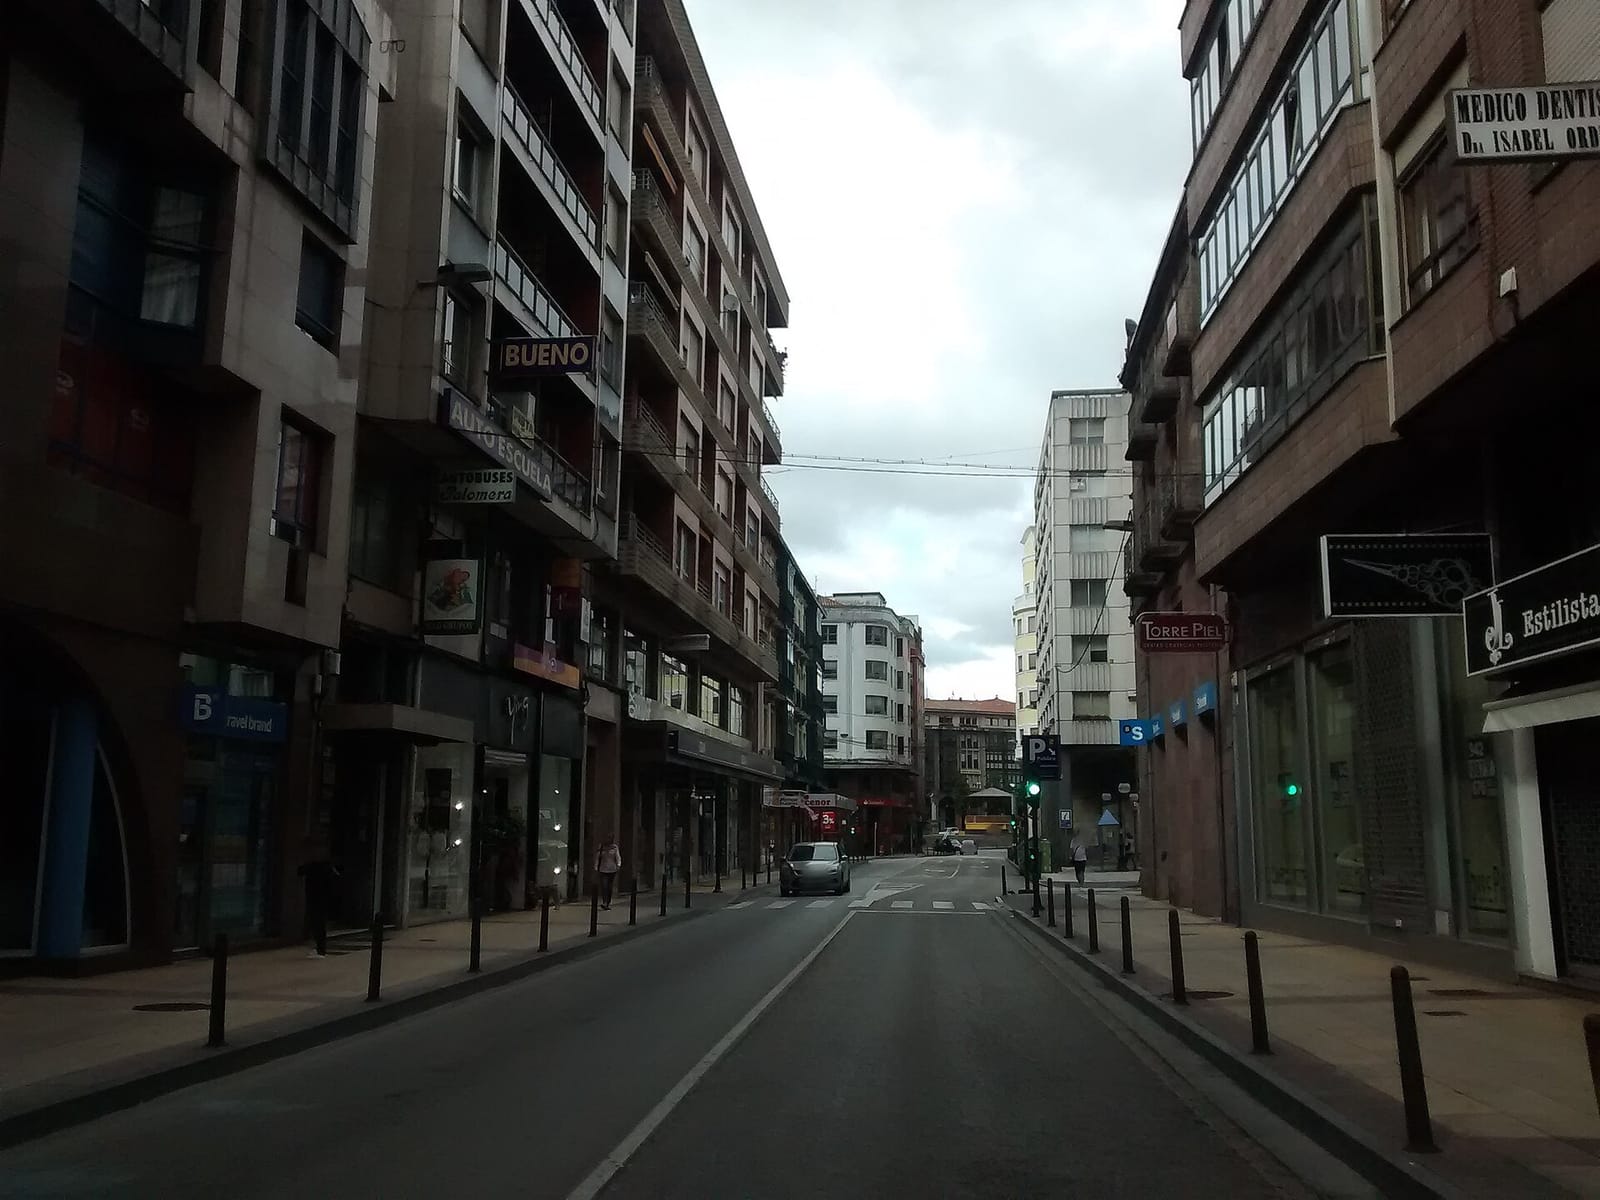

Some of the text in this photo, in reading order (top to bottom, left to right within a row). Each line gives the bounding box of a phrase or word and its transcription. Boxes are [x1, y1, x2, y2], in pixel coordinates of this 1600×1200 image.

[1456, 92, 1527, 124] MEDICO
[1493, 127, 1555, 153] ISABEL
[1566, 126, 1600, 149] ORD
[504, 342, 589, 367] BUENO
[451, 402, 496, 449] AUTO
[498, 436, 552, 497] ESCUELA
[1141, 621, 1223, 640] TORRE PIEL
[248, 715, 272, 732] brand
[1029, 738, 1046, 761] P
